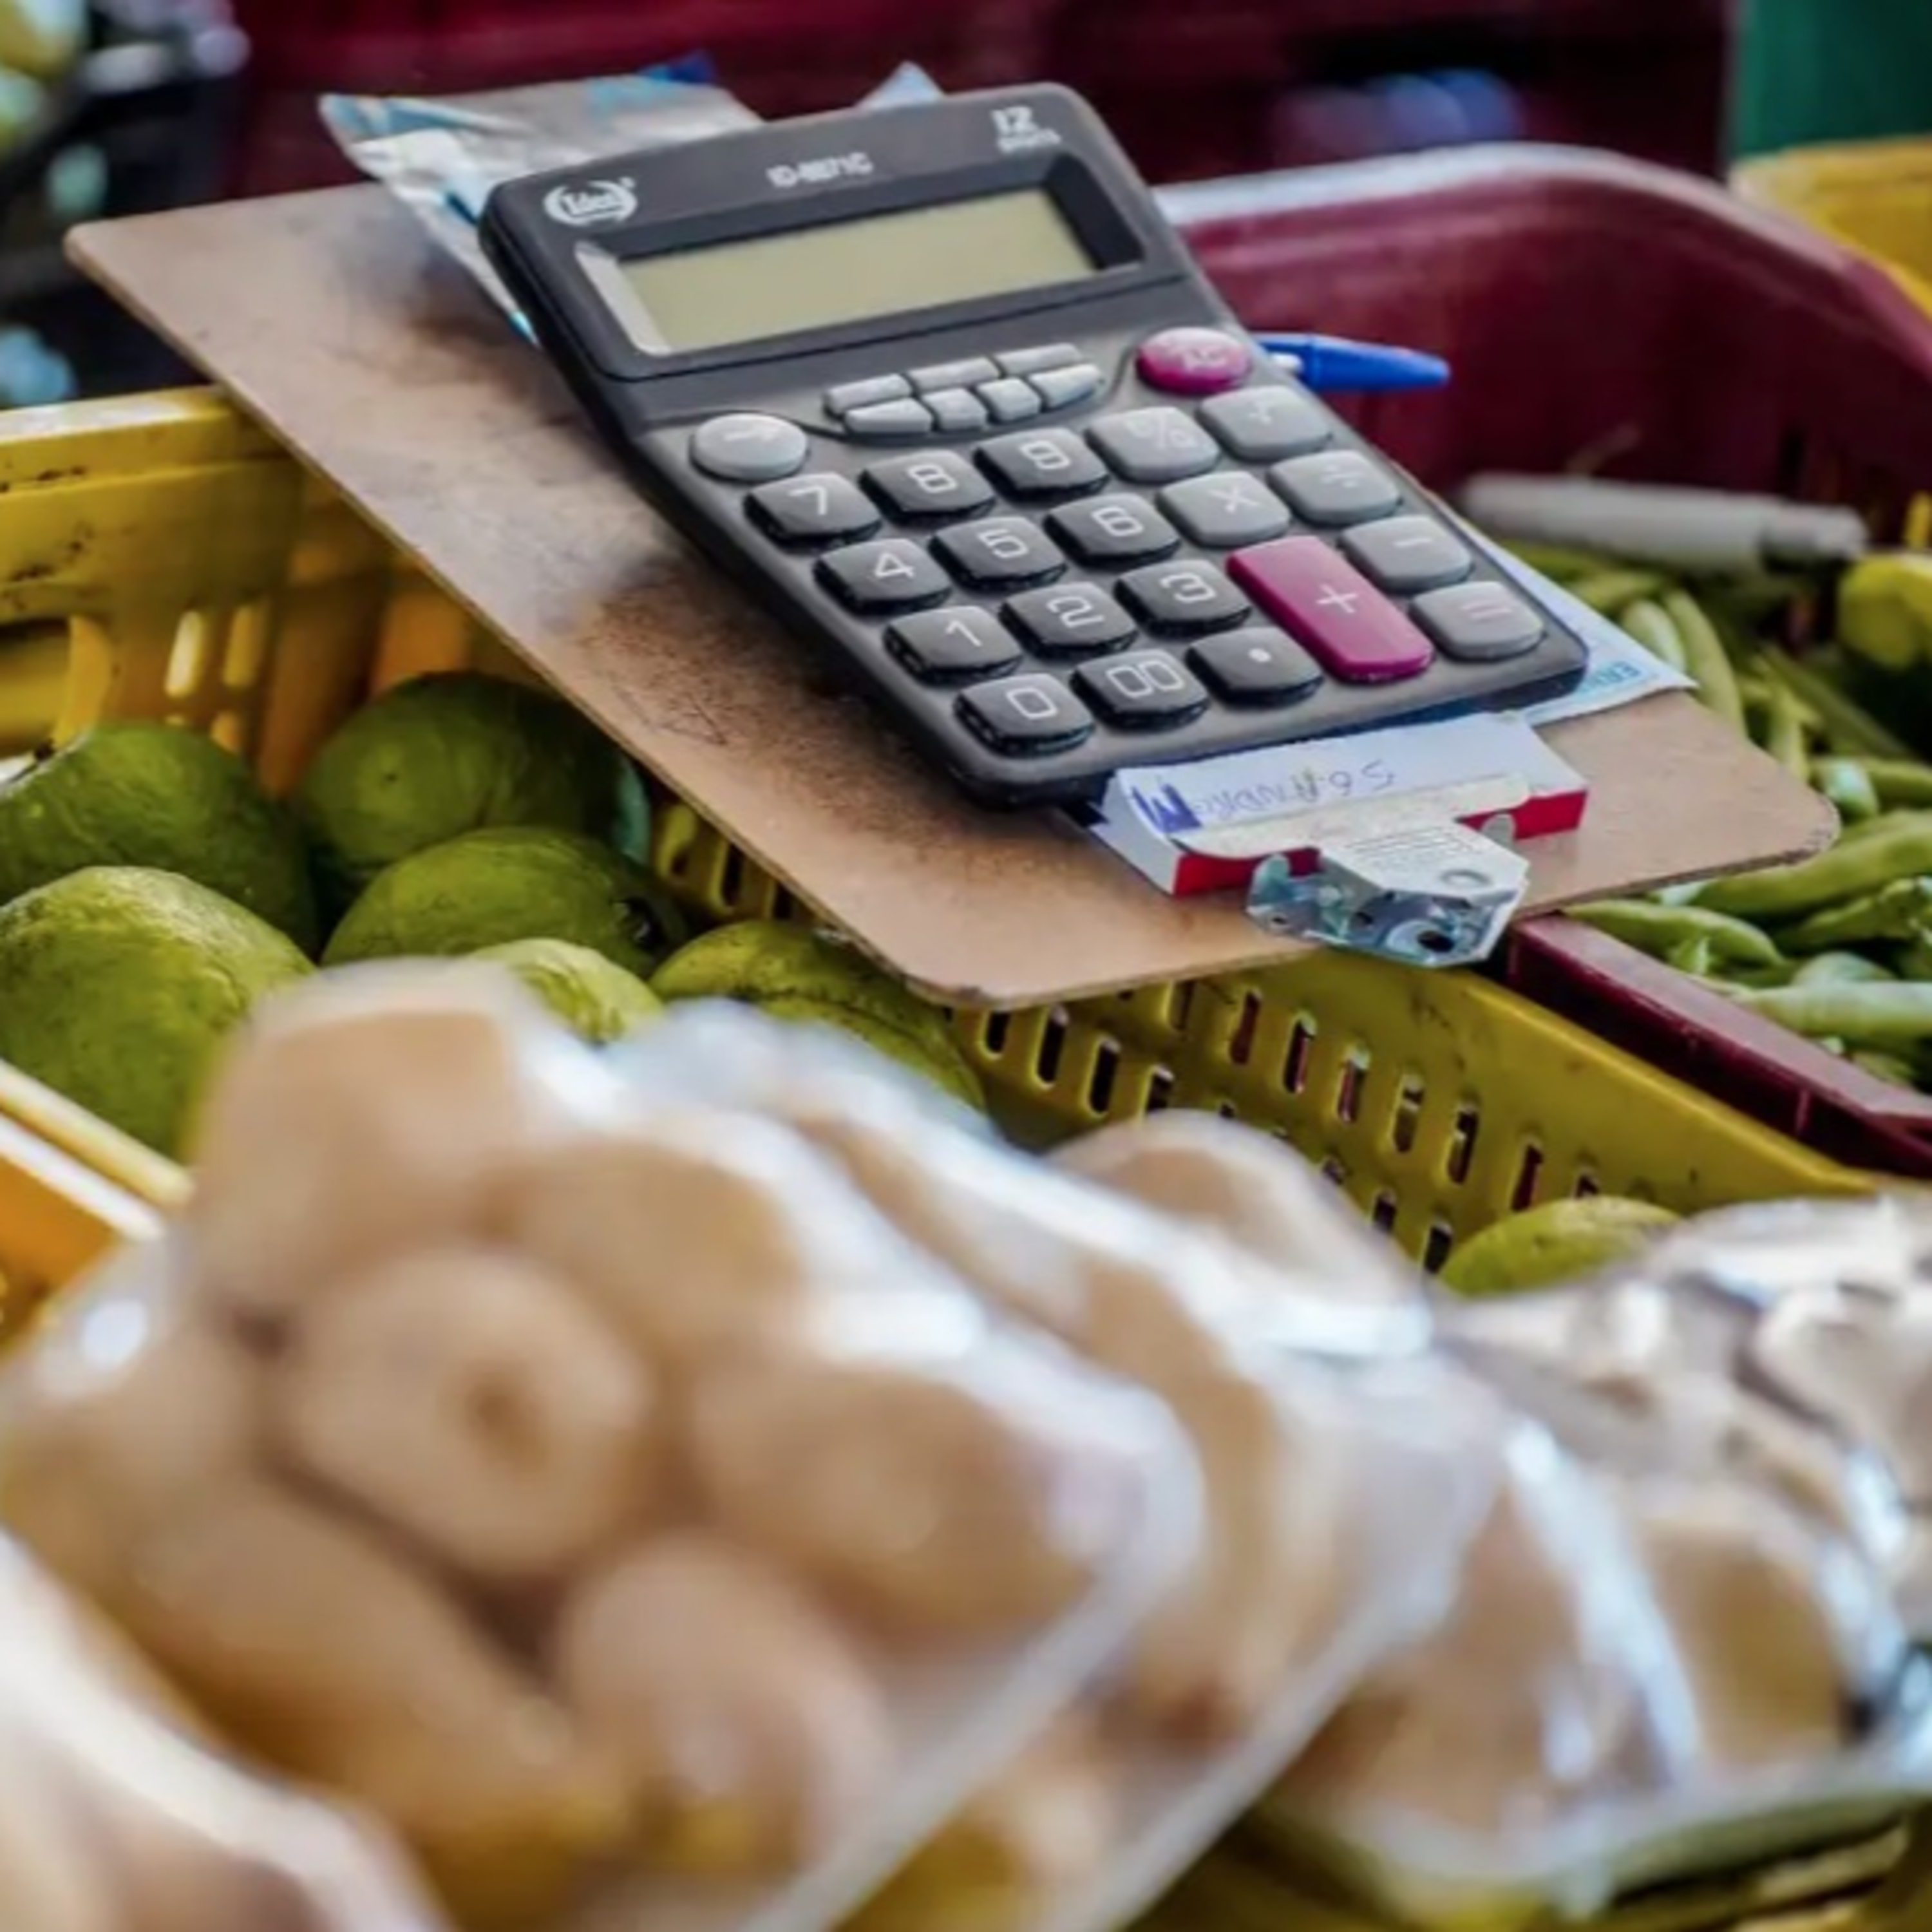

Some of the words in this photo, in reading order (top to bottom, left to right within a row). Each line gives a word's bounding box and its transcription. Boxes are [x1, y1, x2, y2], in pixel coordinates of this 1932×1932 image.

[787, 485, 828, 516] 7
[907, 464, 958, 493] 8
[874, 552, 916, 579] 4
[976, 528, 1028, 560] 5
[1090, 505, 1144, 537] 6
[945, 618, 983, 648] 1
[1046, 594, 1105, 630] 2
[1160, 573, 1217, 603] 3
[1005, 685, 1059, 721] 0
[1105, 659, 1186, 700] 00
